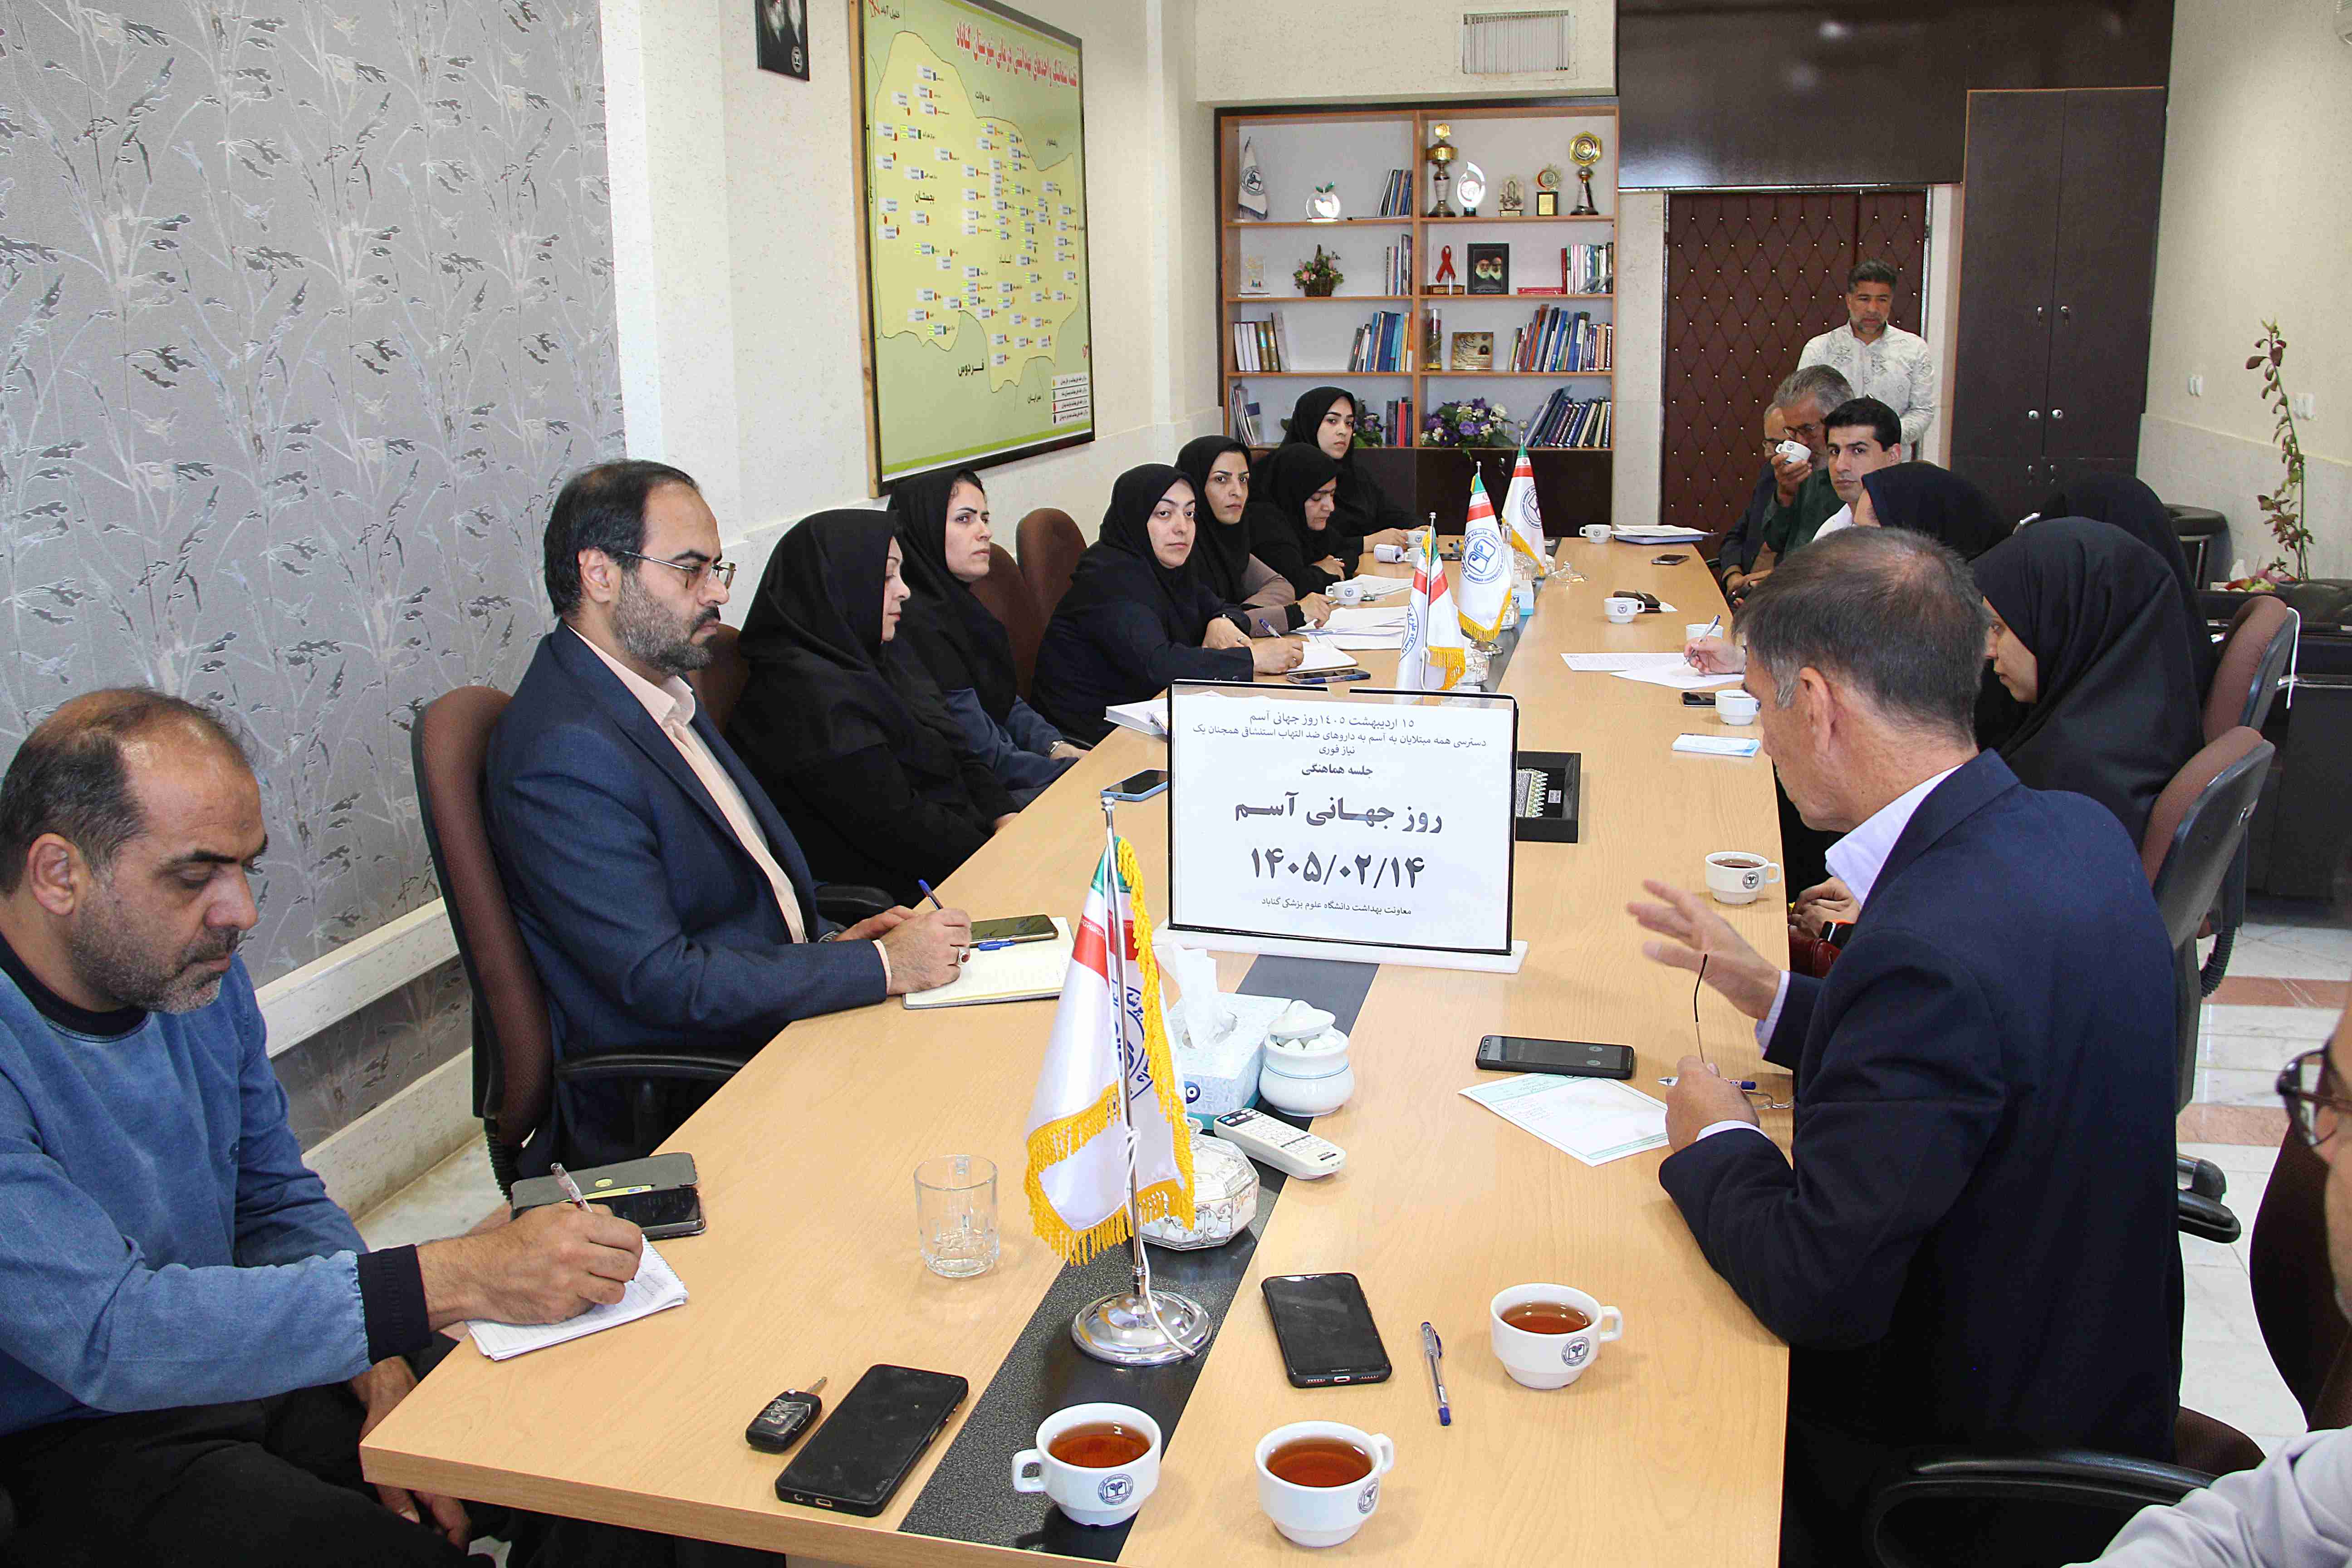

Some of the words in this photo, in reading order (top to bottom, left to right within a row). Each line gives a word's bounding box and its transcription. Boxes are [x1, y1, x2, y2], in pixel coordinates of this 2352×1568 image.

[957, 358, 985, 377] فردوس
[1250, 710, 1269, 725] آسم
[1273, 712, 1299, 725] جهانی
[1349, 716, 1397, 730] اردیبهشت
[1193, 724, 1205, 735] یک
[1278, 729, 1303, 740] التهاب
[1305, 731, 1320, 739] ضد
[1323, 731, 1355, 742] داروهای
[1368, 733, 1386, 745] آسم
[1400, 735, 1431, 746] مبتلایان
[1453, 738, 1486, 748] دسترسی
[1318, 744, 1339, 756] فوری
[1341, 746, 1355, 756] نیاز
[1301, 763, 1345, 776] هماهنگی
[1348, 765, 1373, 779] جلسه
[1235, 791, 1299, 822] آسم
[1306, 797, 1395, 830] جهانی
[1401, 805, 1442, 834] روز
[1261, 896, 1281, 907] گناباد
[1282, 898, 1303, 909] پزشکی
[1305, 901, 1322, 911] علوم
[1323, 900, 1350, 910] دانشگاه
[1352, 903, 1382, 914] بهداشت
[1384, 906, 1411, 916] معاونت
